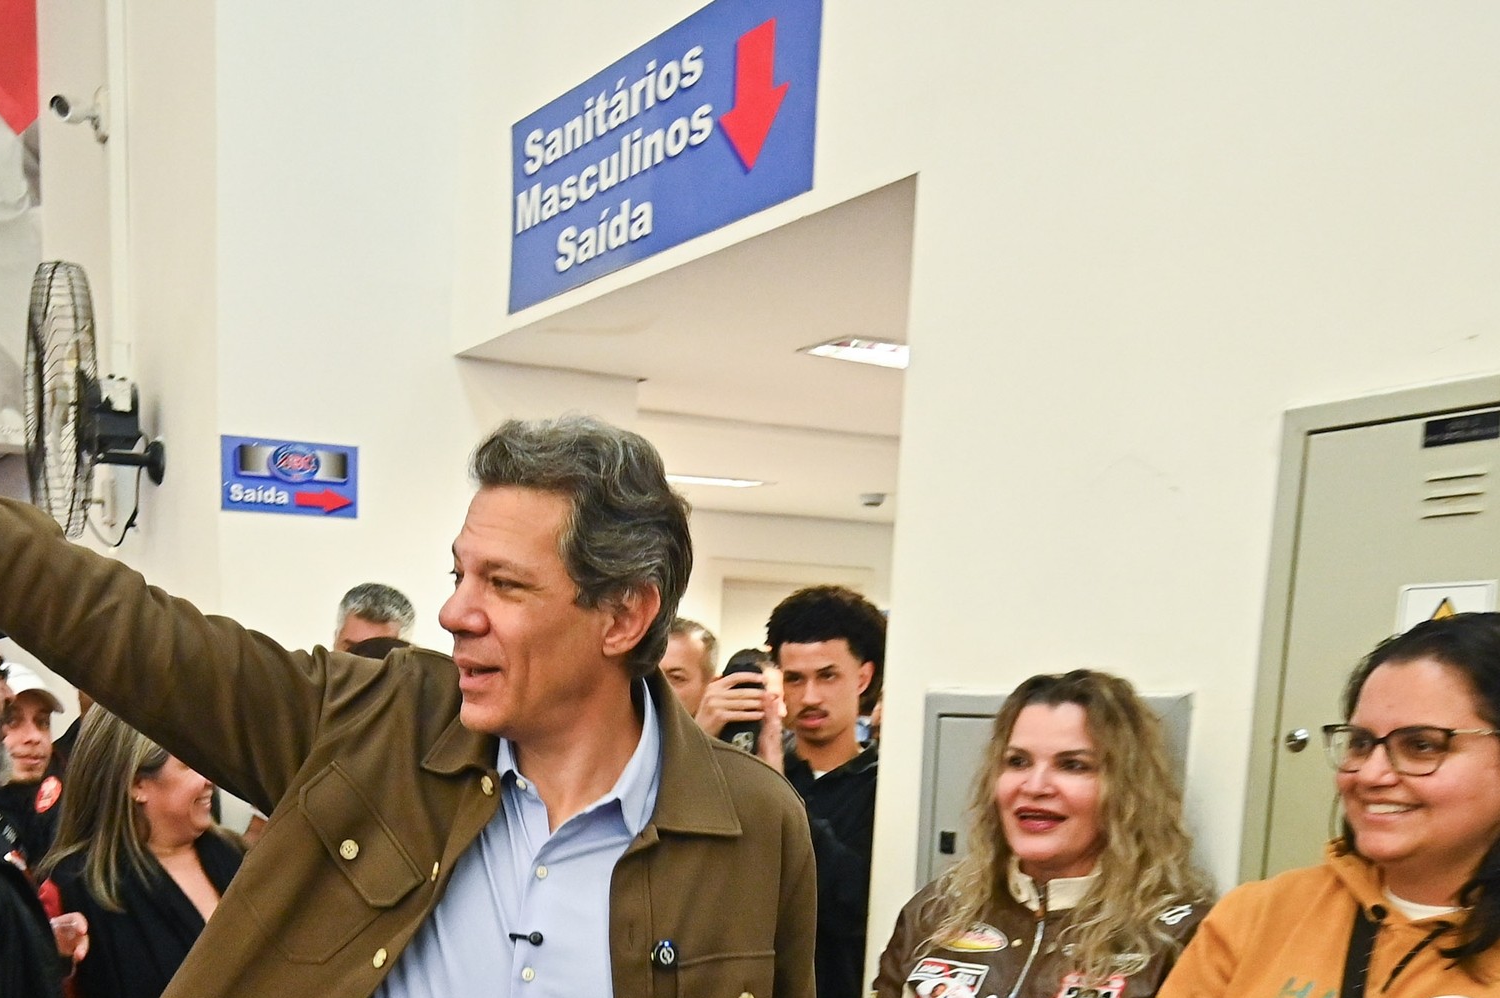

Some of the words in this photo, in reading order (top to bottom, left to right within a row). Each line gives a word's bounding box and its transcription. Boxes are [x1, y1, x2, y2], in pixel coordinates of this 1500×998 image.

[523, 44, 705, 176] Sanitários
[514, 102, 714, 236] Masculinos
[554, 198, 654, 273] Saída
[229, 483, 290, 505] Saída
